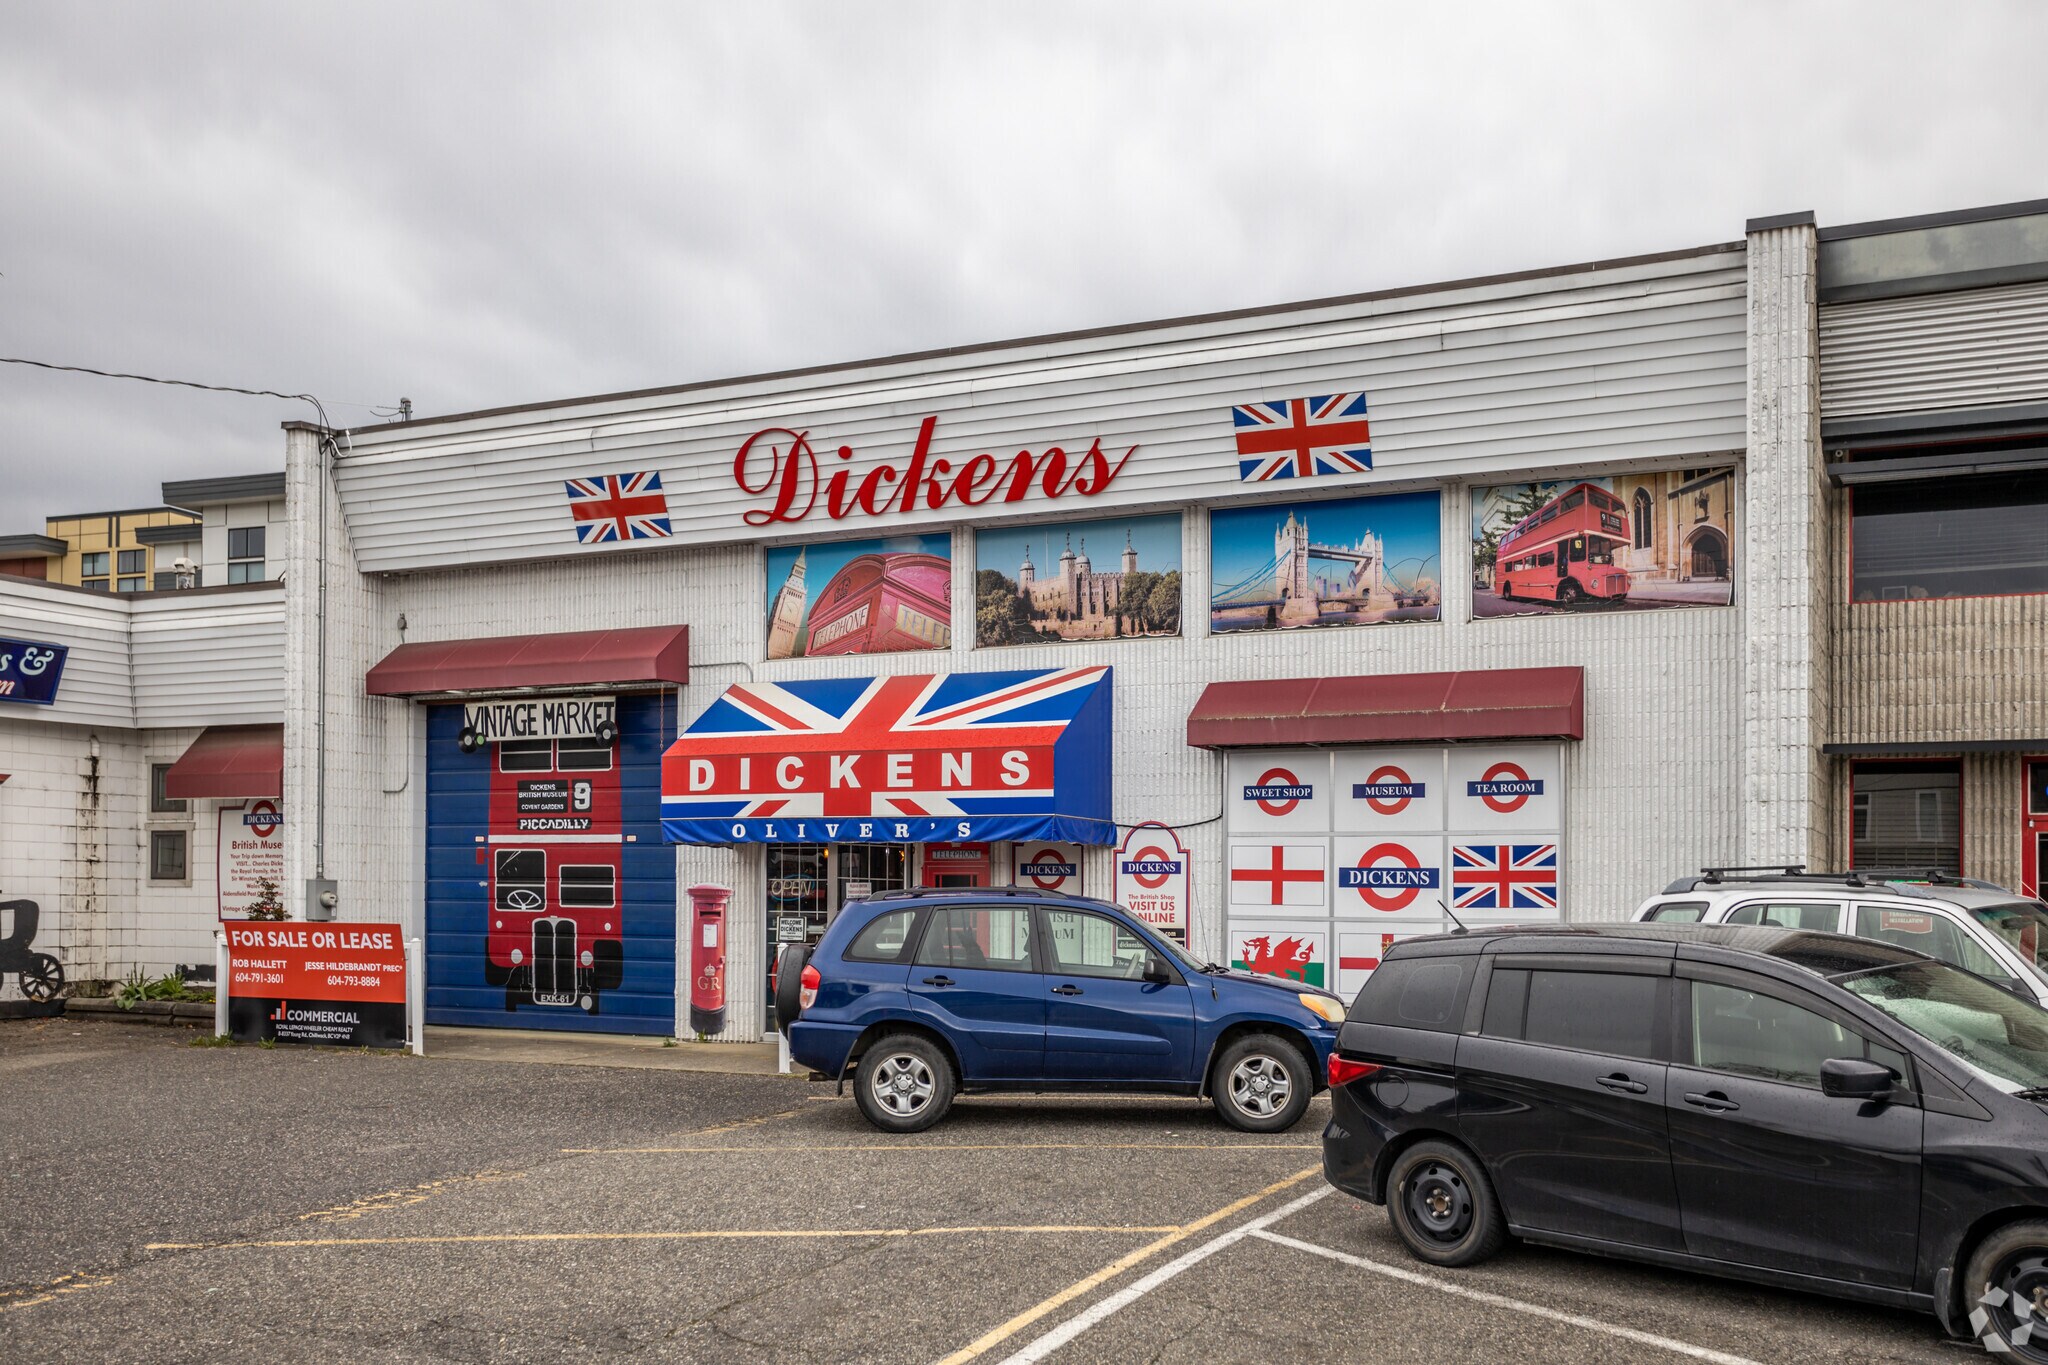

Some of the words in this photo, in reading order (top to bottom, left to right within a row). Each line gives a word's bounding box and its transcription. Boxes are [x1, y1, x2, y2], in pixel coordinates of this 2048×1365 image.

[733, 415, 1140, 526] Dickens
[816, 606, 868, 647] TELEPHONE
[19, 646, 55, 676] &
[465, 703, 538, 738] VINTAGE
[543, 701, 614, 735] MARKET
[689, 750, 1030, 791] DICKENS
[1245, 787, 1282, 799] SWEET
[1283, 786, 1311, 799] SHOP
[1364, 785, 1414, 797] MUSEUM
[1475, 782, 1498, 794] TEA
[1499, 781, 1536, 794] ROOM
[518, 791, 541, 799] BRITISH
[574, 782, 591, 810] 9
[247, 814, 281, 824] DICKENS
[519, 818, 589, 830] PICCADILLY
[731, 821, 972, 839] OLIVER'S
[232, 840, 258, 850] British
[260, 840, 284, 850] Muse
[935, 850, 979, 859] TELEPHONE
[1026, 865, 1071, 875] DICKENS
[1128, 863, 1176, 872] DICKENS
[1349, 869, 1430, 886] DICKENS
[771, 880, 811, 896] OPEN
[1129, 901, 1156, 911] VISIT
[1160, 901, 1175, 911] US
[231, 930, 266, 947] FOR
[267, 931, 308, 948] SALE
[312, 931, 337, 949] OR
[340, 932, 393, 950] LEASE
[232, 958, 249, 968] ROB
[250, 959, 287, 969] HALLETT
[304, 961, 324, 971] JESSE
[326, 962, 381, 972] HILDEBRANDT
[235, 972, 284, 984] 604-791-3601
[327, 975, 380, 987] 604-793-8884
[540, 994, 570, 1003] EXK-61
[287, 1009, 360, 1024] COMMERCIAL
